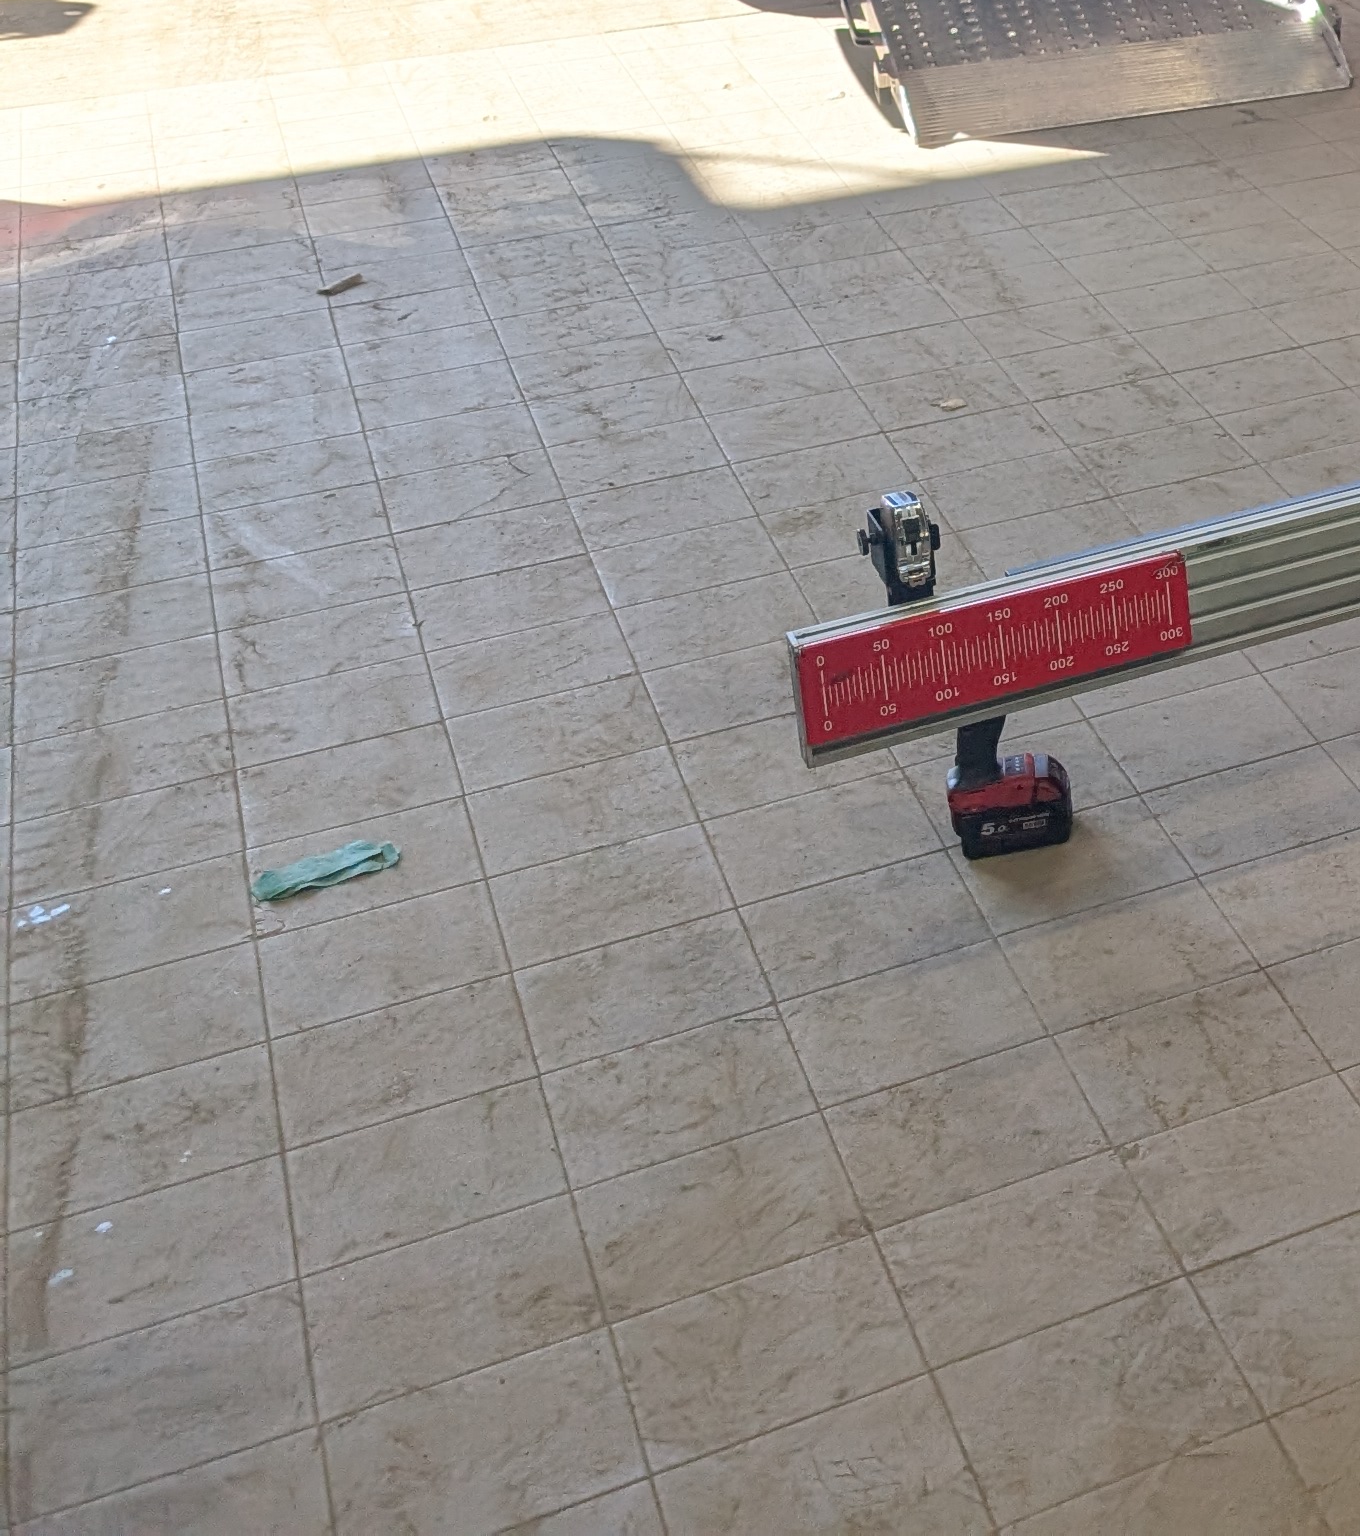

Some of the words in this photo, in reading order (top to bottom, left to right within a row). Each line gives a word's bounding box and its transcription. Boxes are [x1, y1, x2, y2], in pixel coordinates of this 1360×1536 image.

[816, 656, 824, 666] 0
[873, 639, 889, 652] 50
[928, 622, 953, 638] 100
[986, 608, 1011, 623] 150
[1044, 594, 1068, 609] 200
[1100, 579, 1124, 594] 250
[1156, 565, 1178, 580] 300
[824, 720, 832, 731] 0
[880, 704, 897, 716] 50
[936, 687, 960, 701] 100
[994, 671, 1018, 686] 150
[1050, 656, 1074, 671] 200
[1105, 641, 1130, 656] 250
[1160, 626, 1183, 641] 300
